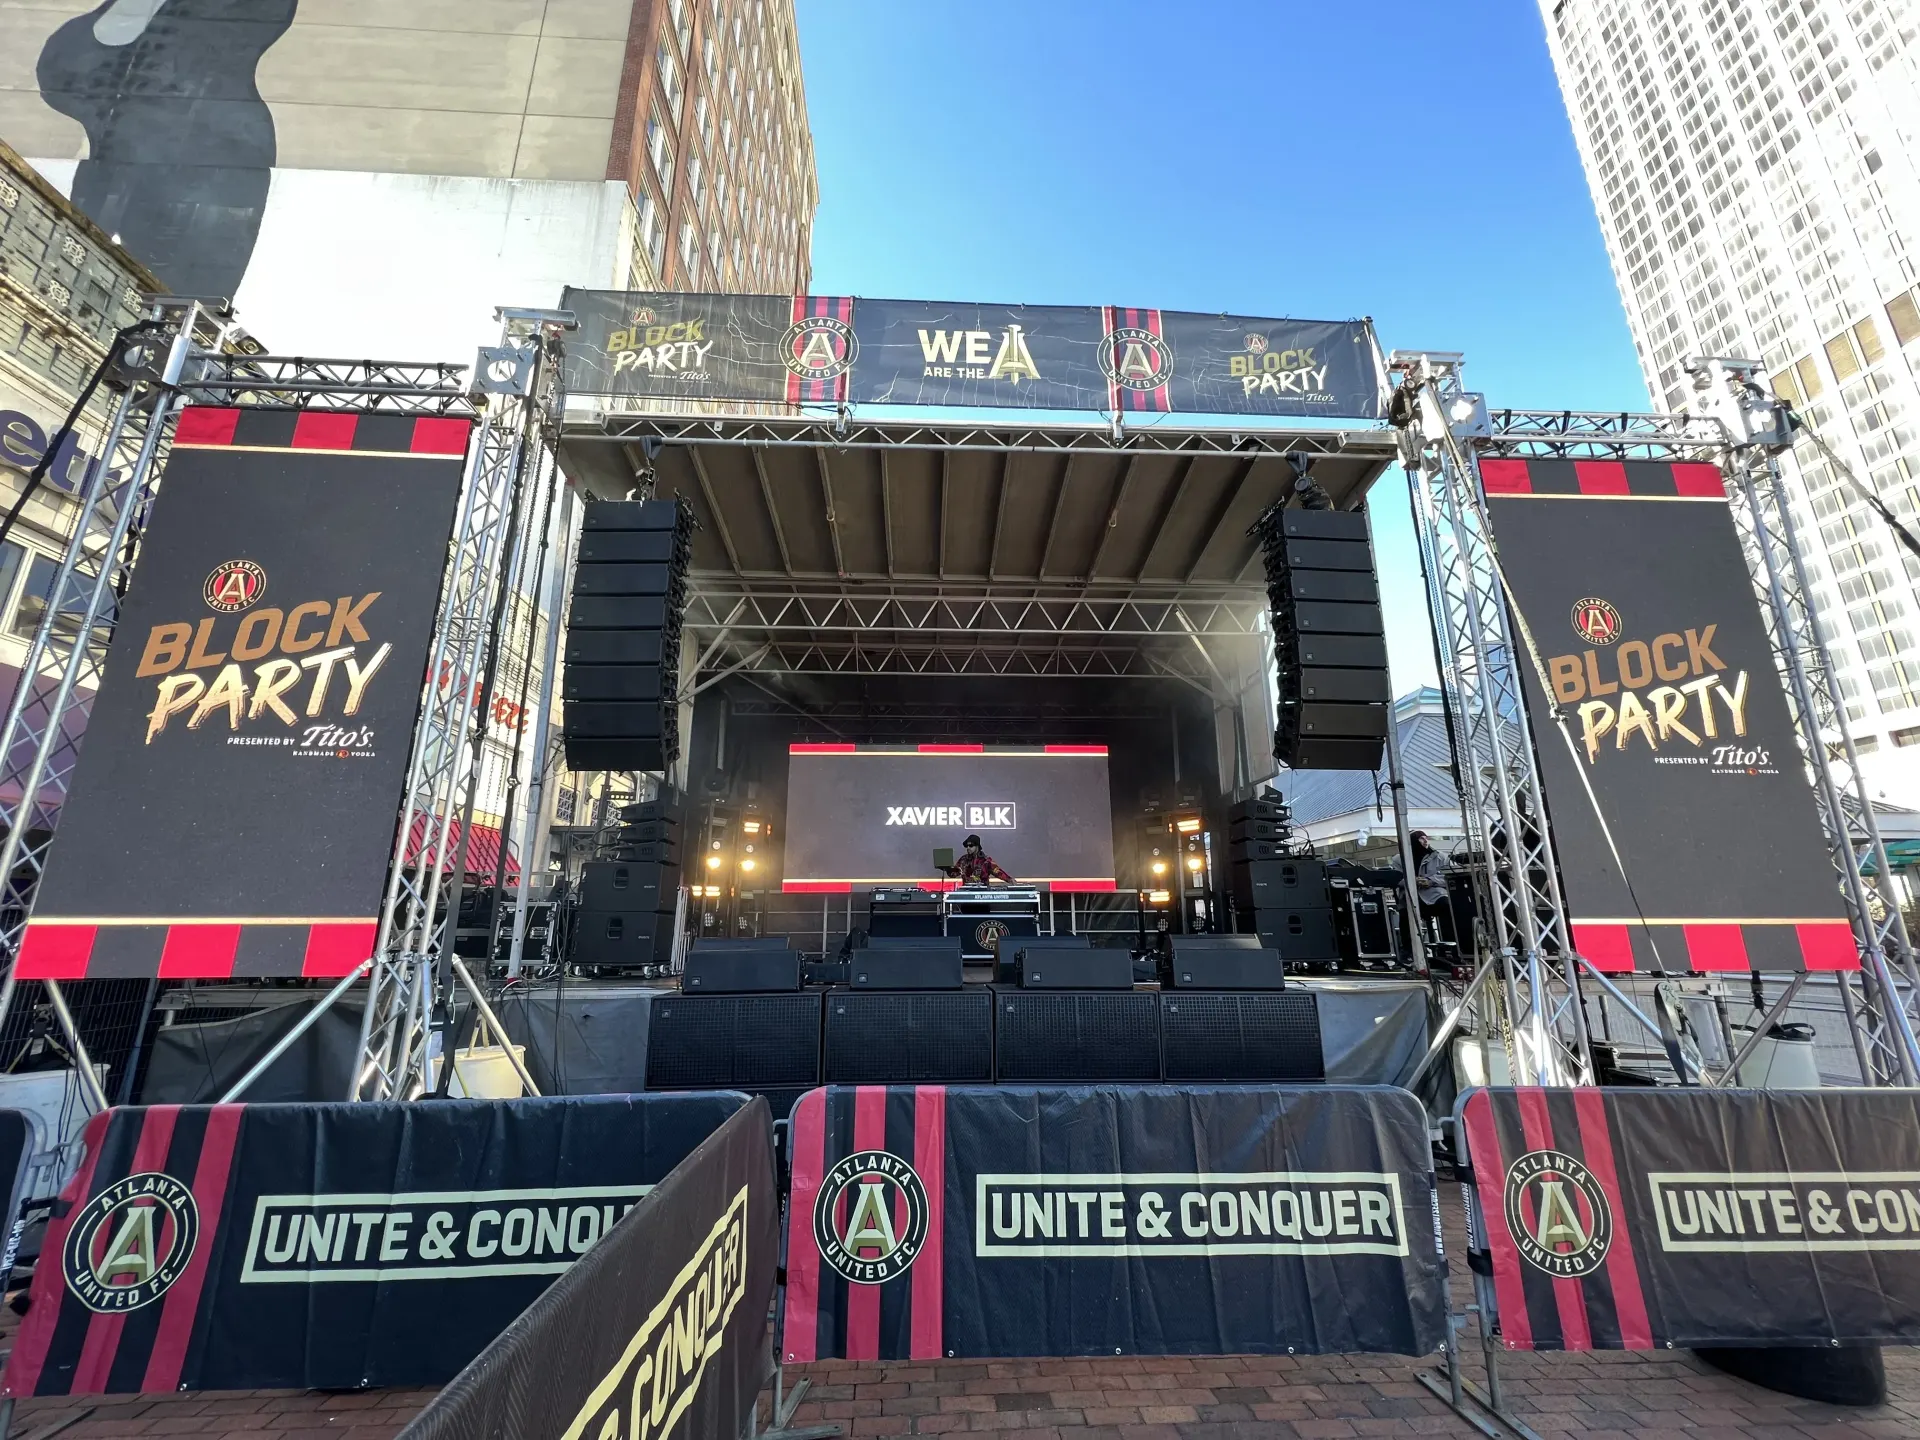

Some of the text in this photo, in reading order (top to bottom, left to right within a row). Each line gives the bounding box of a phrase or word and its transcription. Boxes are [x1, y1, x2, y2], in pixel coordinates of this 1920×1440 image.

[607, 320, 705, 351] BLOCK
[794, 319, 848, 335] ATLANTA
[613, 340, 713, 376] PARTY
[917, 329, 992, 364] WE
[679, 370, 711, 380] Tito's
[788, 358, 830, 377] UNITED
[924, 367, 985, 379] ARE THE
[1230, 348, 1316, 377] BLOCK
[1153, 372, 1166, 384] FC
[1241, 365, 1327, 399] PARTY
[1305, 393, 1335, 402] Tito's
[218, 561, 260, 576] ATLANTA
[207, 595, 255, 610] UNITED FC
[1576, 599, 1610, 611] ATLANTA
[135, 591, 382, 678] BLOCK
[1580, 630, 1609, 644] UNITED
[1548, 624, 1727, 704] BLOCK
[145, 641, 394, 745] PARTY
[1577, 670, 1750, 764] PARTY
[227, 723, 375, 748] PRESENTED BY Tito's
[1654, 757, 1698, 765] PRESENTED
[1712, 744, 1770, 765] Tito's
[886, 807, 1011, 825] XAVIER BLK
[833, 1156, 912, 1186] ATLANTA
[1512, 1155, 1586, 1184] ATLANTA
[101, 1177, 187, 1212] ATLANTA
[991, 1189, 1394, 1240] UNITE & CONQUER
[1666, 1189, 1802, 1234] UNITE
[1807, 1189, 1846, 1234] &
[264, 1211, 412, 1264] UNITE
[418, 1211, 461, 1260] &
[826, 1241, 915, 1279] UNITED FC
[1521, 1237, 1605, 1272] UNITED FC
[74, 1268, 173, 1307] UNITED FC
[630, 1218, 740, 1440] CONQUER
